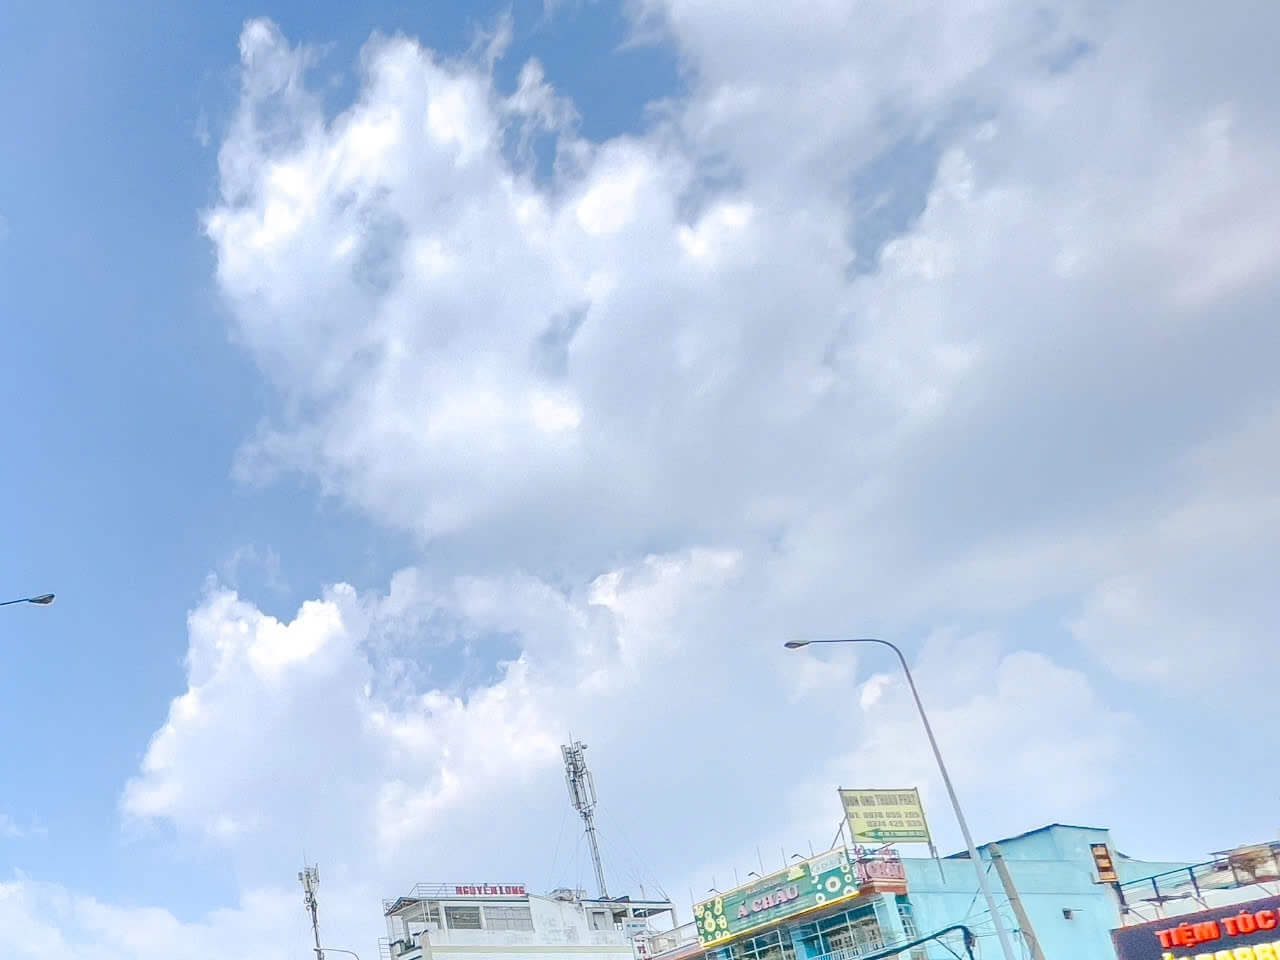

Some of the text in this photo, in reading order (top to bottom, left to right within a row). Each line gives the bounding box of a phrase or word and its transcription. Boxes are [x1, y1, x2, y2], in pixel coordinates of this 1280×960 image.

[751, 884, 800, 913] CHÂU
[1154, 920, 1221, 949] TIỆM
[1221, 909, 1278, 937] TÓC
